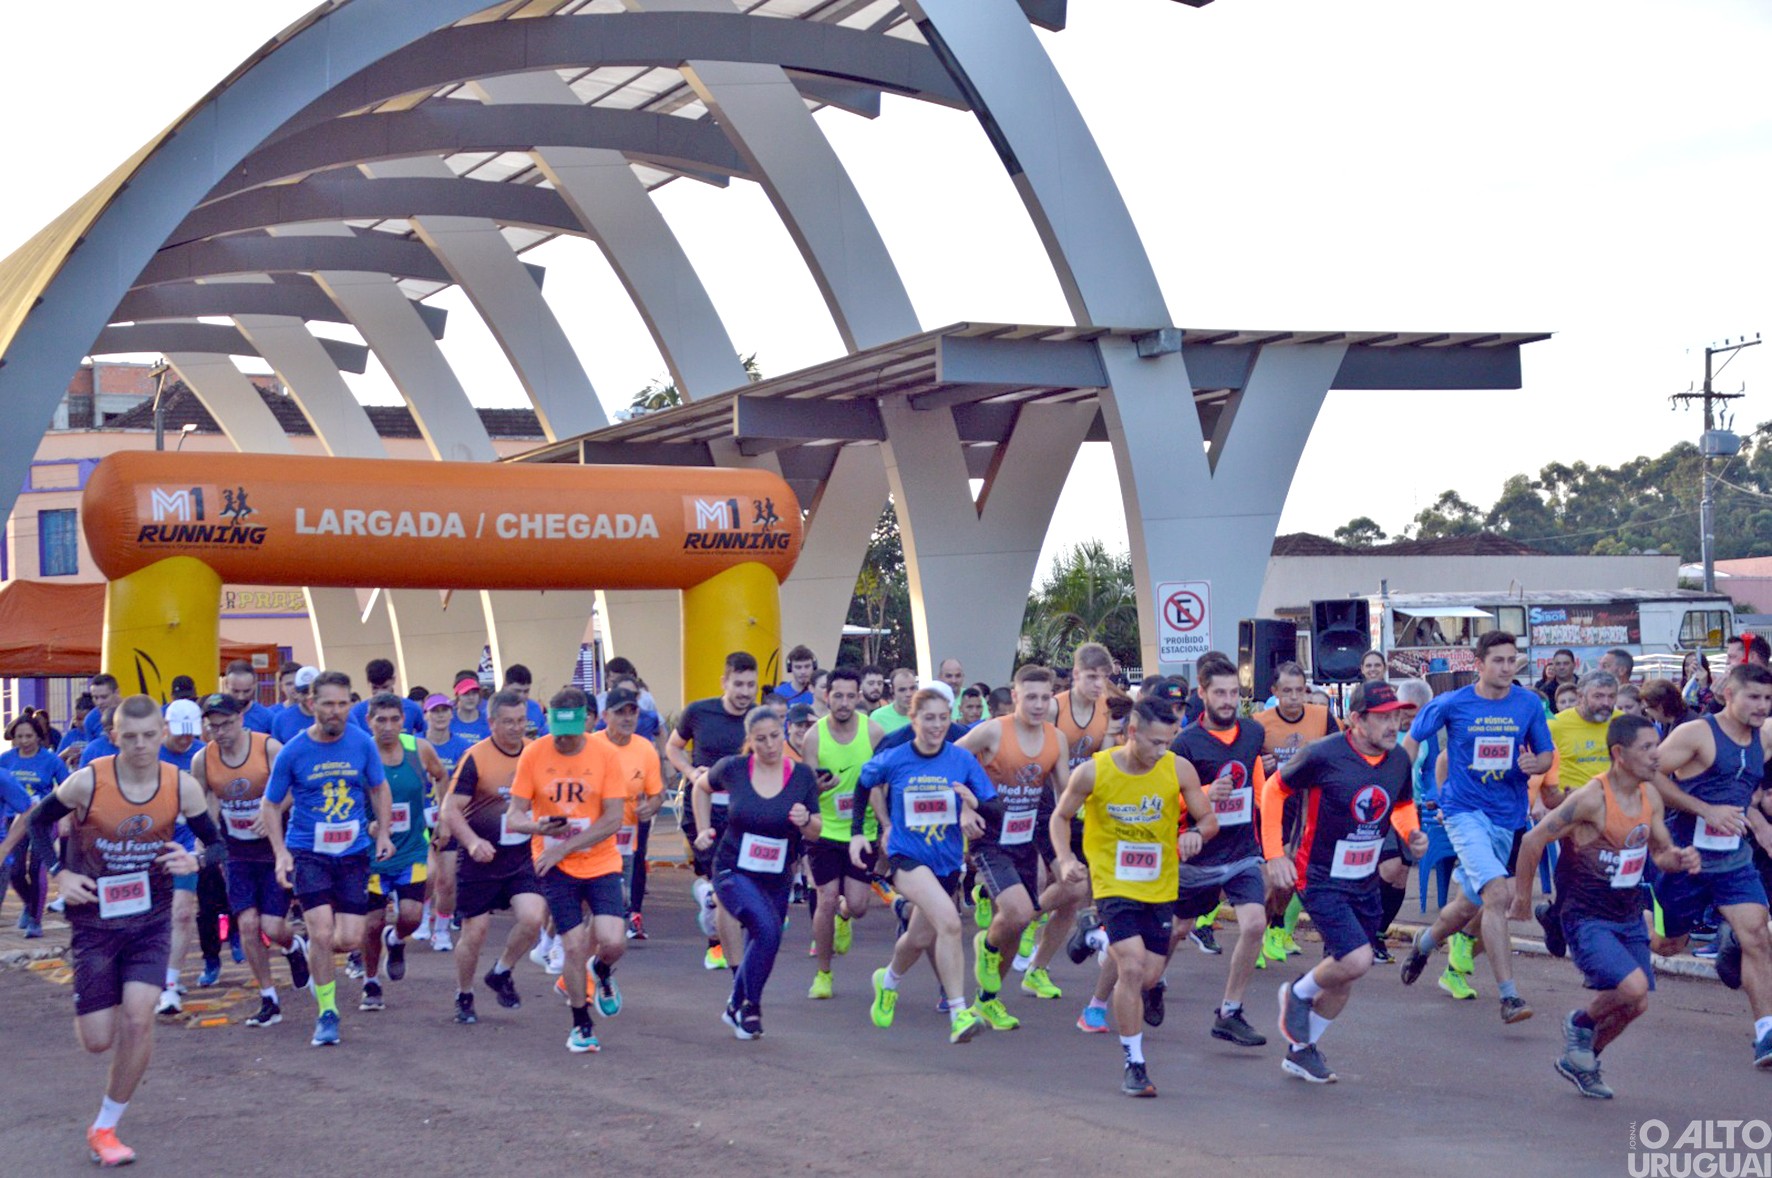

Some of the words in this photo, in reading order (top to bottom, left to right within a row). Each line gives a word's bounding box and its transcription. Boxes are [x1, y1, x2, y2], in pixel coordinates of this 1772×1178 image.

[151, 487, 204, 522] M1
[695, 498, 740, 530] M1
[295, 508, 466, 538] LARGADA
[475, 512, 485, 539] /
[496, 513, 660, 539] CHEGADA
[138, 525, 268, 544] RUNNING
[683, 532, 791, 550] RUNNING
[239, 591, 309, 610] PRAÇ
[1166, 635, 1204, 645] PROIBIDO
[1161, 645, 1209, 654] ESTACIONAR
[1482, 746, 1507, 758] 065
[550, 782, 585, 803] JR
[998, 784, 1021, 795] Med
[918, 801, 944, 812] 012
[1219, 802, 1242, 812] 059
[95, 838, 123, 852] Med
[753, 847, 780, 860] 032
[1126, 854, 1154, 865] 070
[1599, 850, 1620, 864] Me
[110, 884, 141, 899] 056
